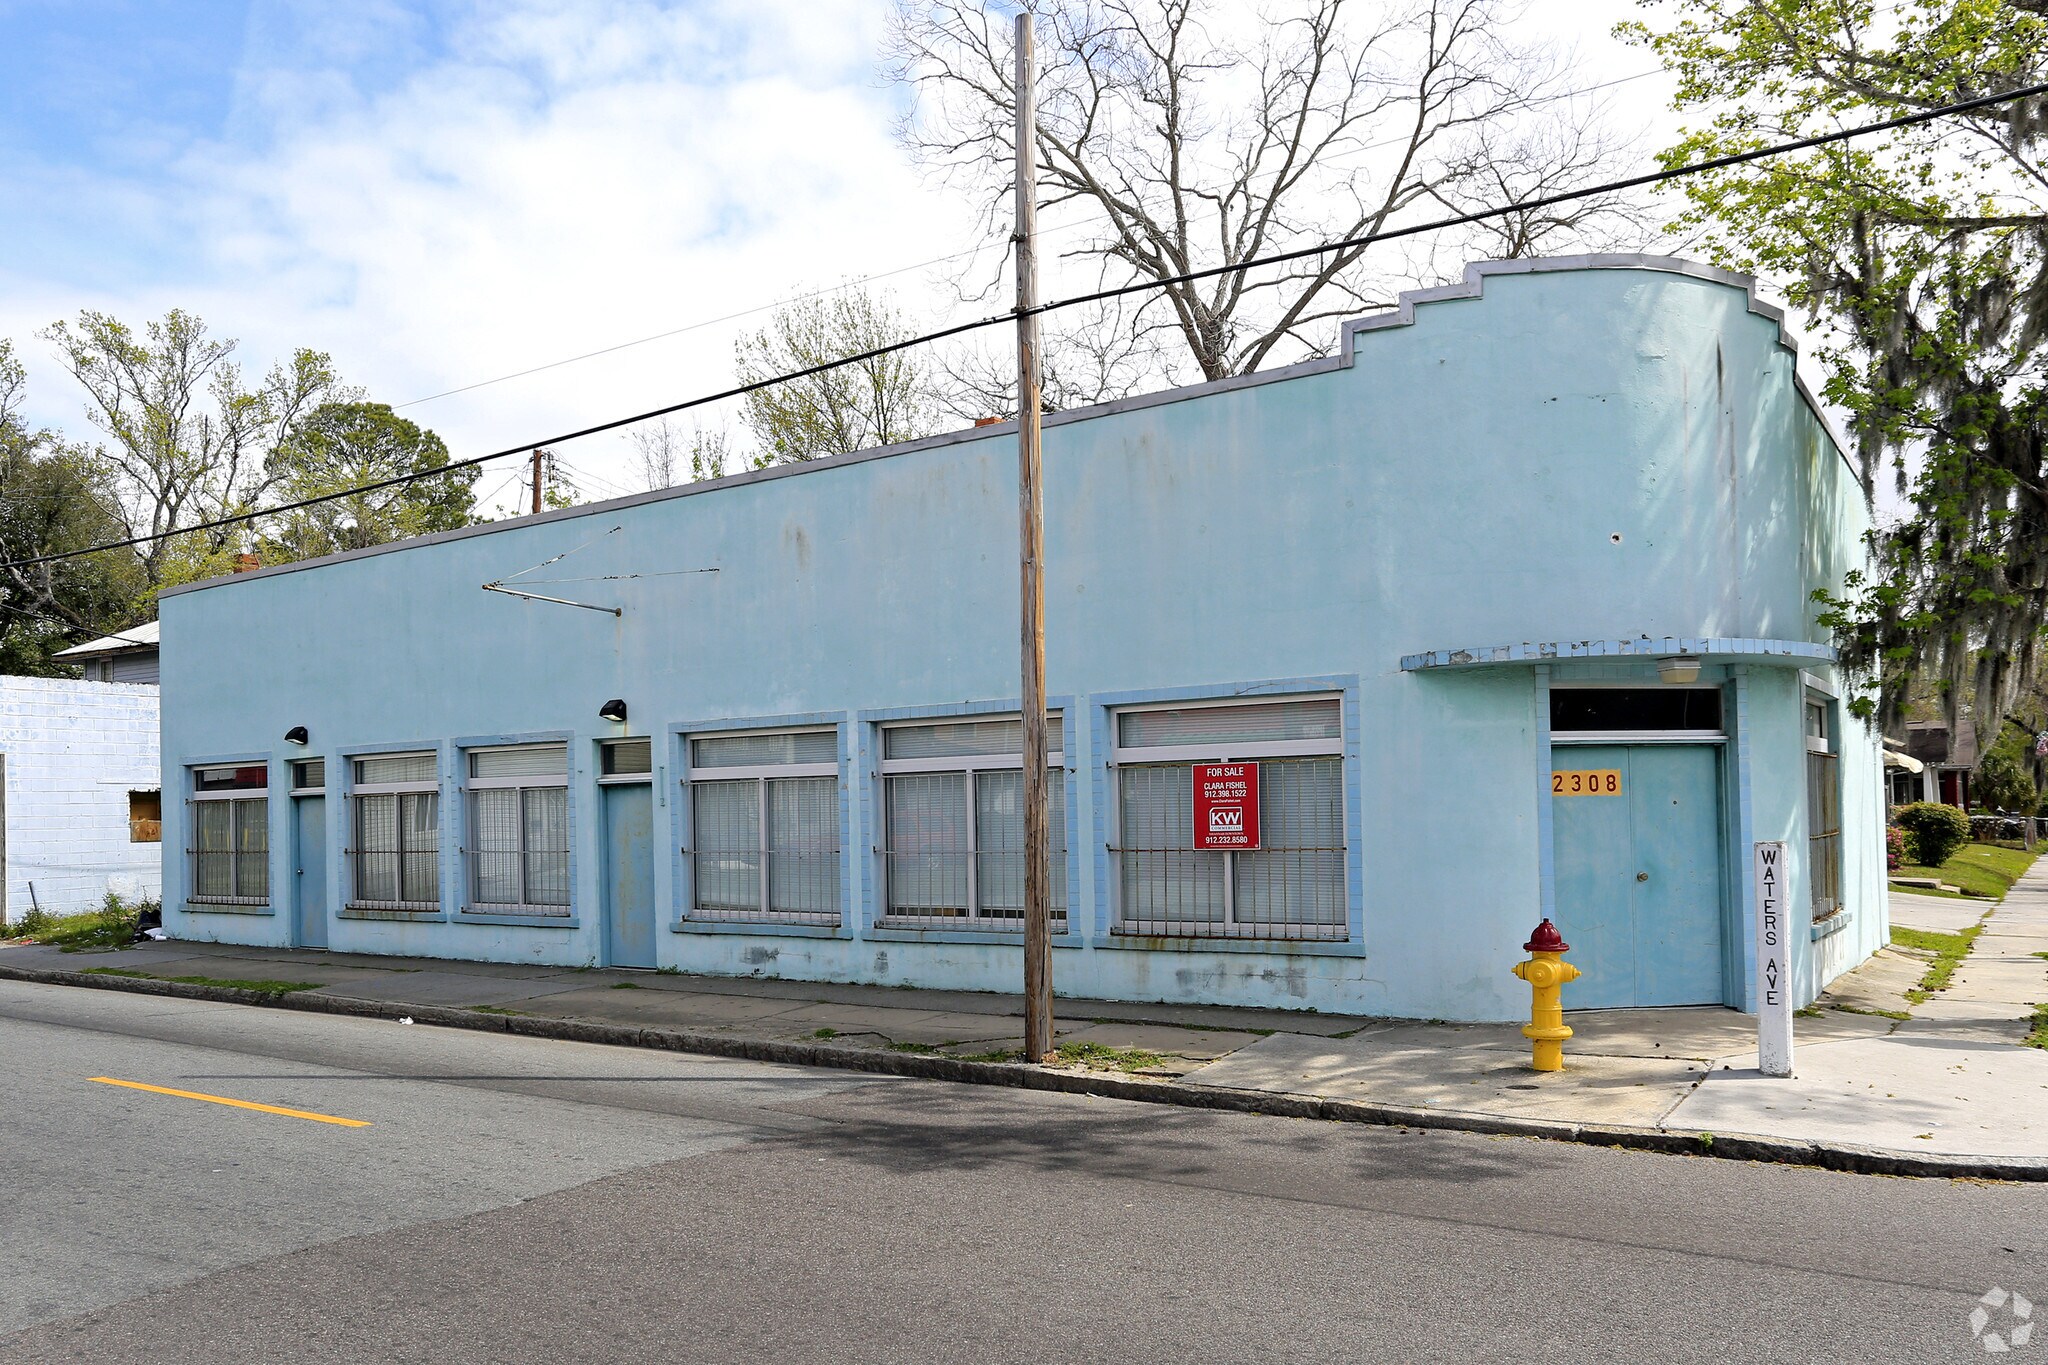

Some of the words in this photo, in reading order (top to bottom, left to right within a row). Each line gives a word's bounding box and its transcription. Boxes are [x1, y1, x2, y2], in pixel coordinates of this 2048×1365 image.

[1207, 768, 1222, 777] FOR
[1224, 767, 1244, 776] SALE
[1204, 782, 1224, 790] CLARA
[1226, 781, 1247, 789] FISHEL
[1553, 774, 1617, 792] 2308
[1205, 790, 1247, 798] 912.398.1522
[1211, 812, 1240, 825] KW
[1205, 836, 1248, 844] 912.232.8580
[1761, 850, 1777, 946] WATERS
[1766, 958, 1779, 1006] AVE
